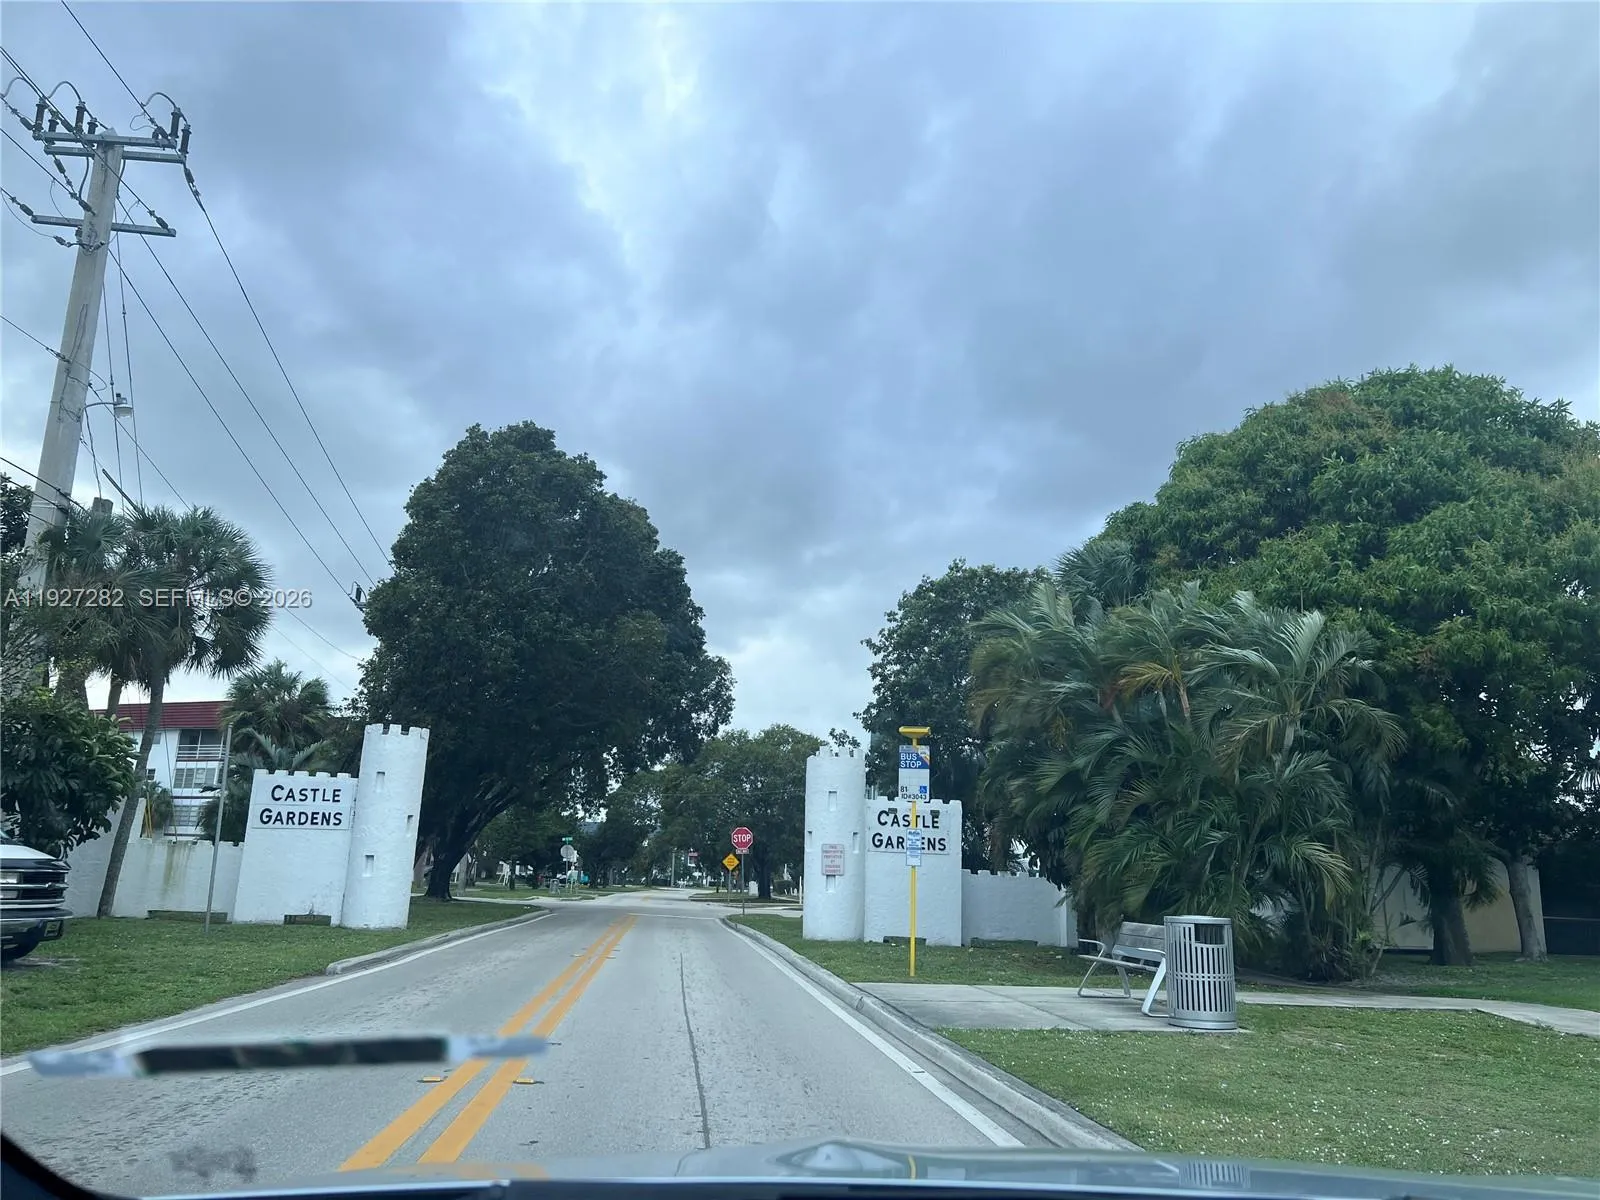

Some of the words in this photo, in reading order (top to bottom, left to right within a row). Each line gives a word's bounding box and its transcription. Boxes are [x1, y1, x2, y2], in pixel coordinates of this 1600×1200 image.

[900, 752, 918, 760] BUS
[900, 760, 922, 768] STOP
[270, 784, 342, 803] CASTLE
[259, 807, 343, 826] GARDENS
[733, 834, 751, 843] STOP
[871, 832, 947, 851] GARENS
